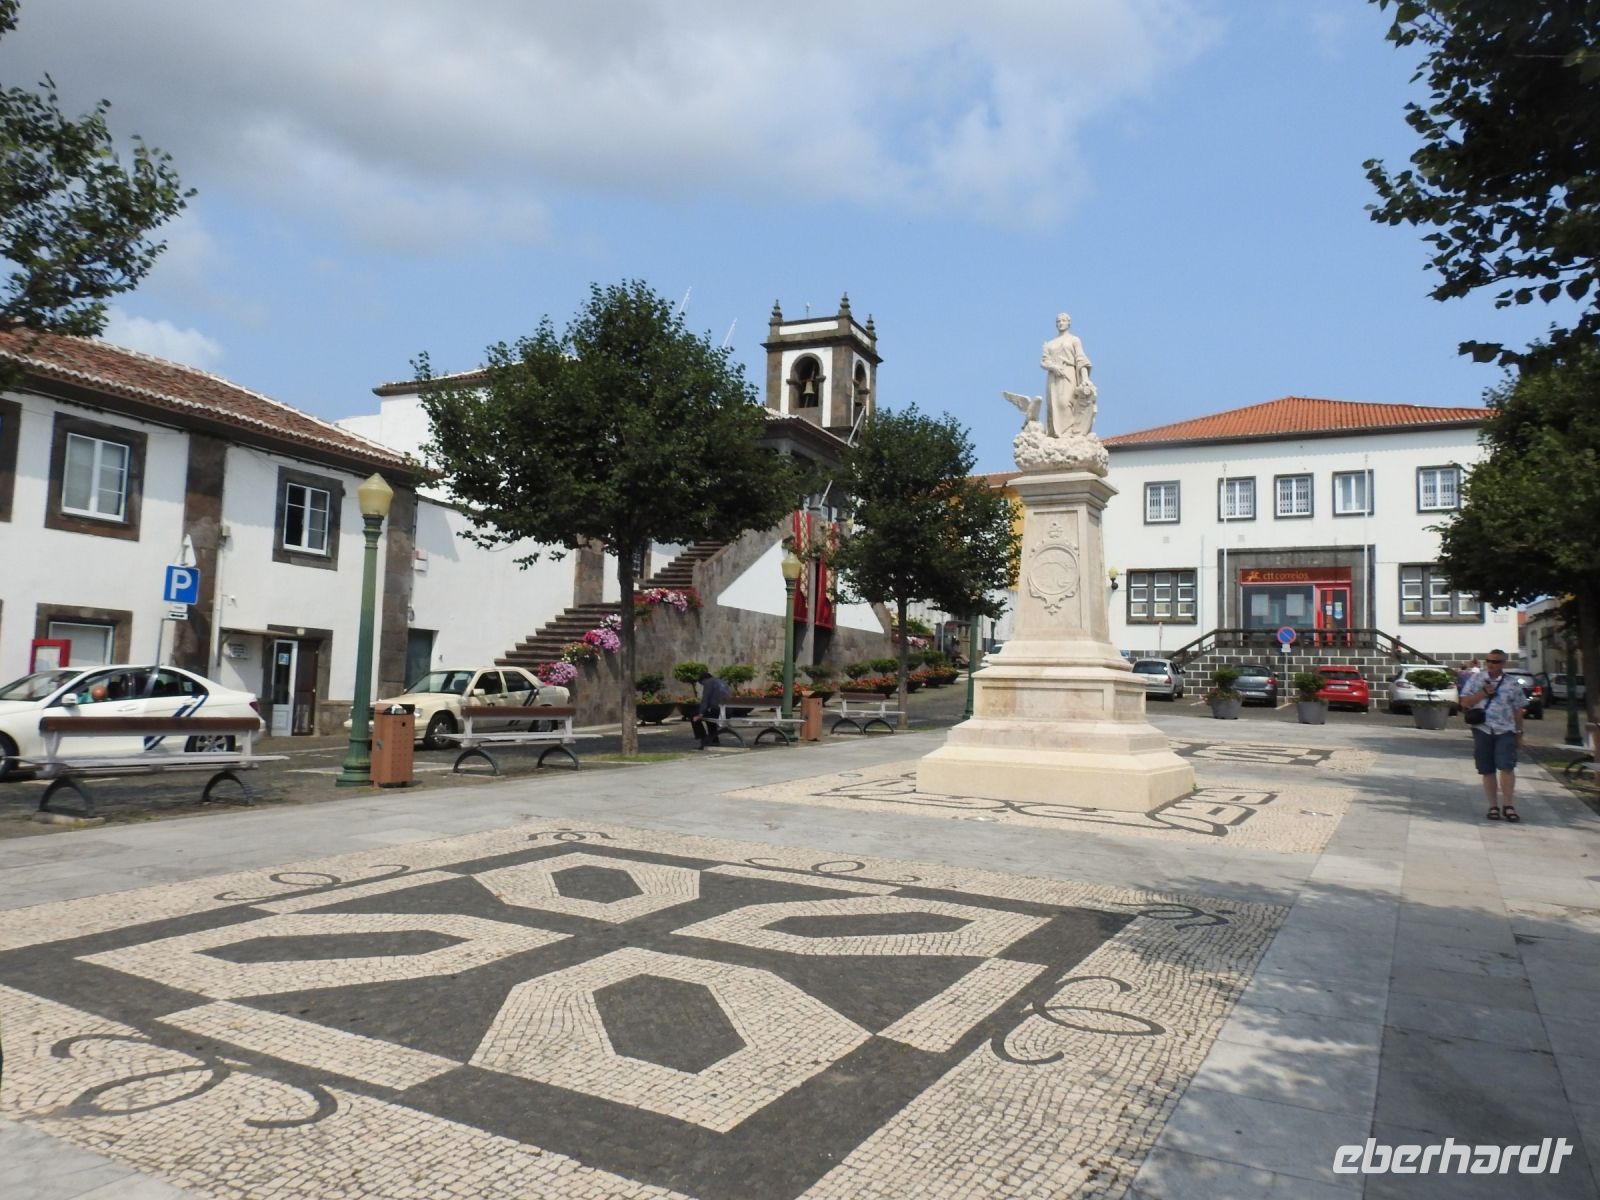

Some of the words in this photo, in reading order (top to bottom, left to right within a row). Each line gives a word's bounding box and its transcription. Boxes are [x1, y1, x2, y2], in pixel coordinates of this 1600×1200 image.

[170, 569, 192, 599] P
[1262, 572, 1274, 581] ctt
[1275, 570, 1309, 581] correios
